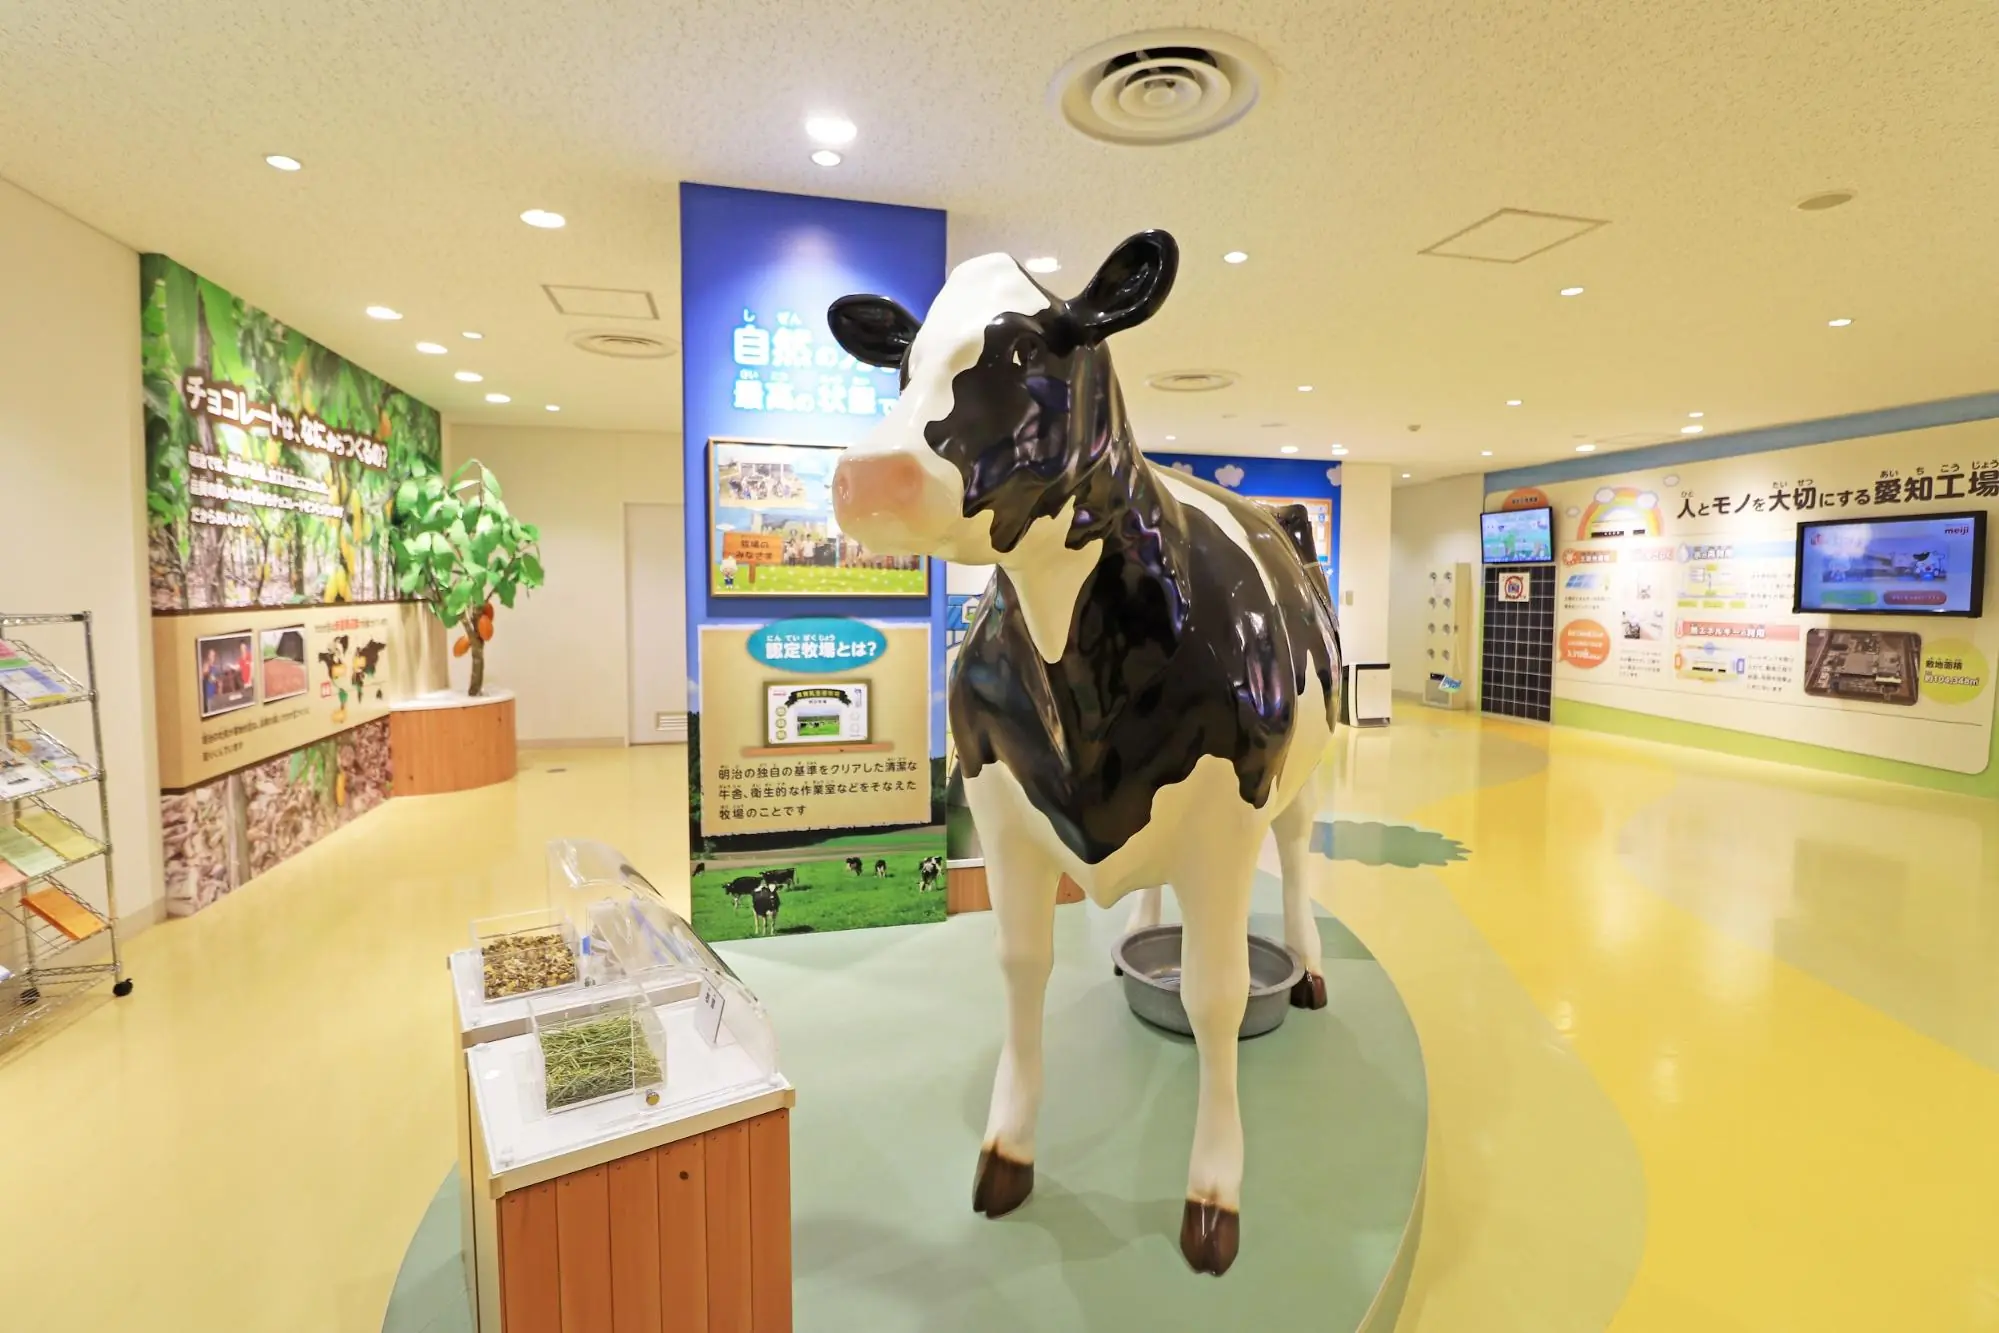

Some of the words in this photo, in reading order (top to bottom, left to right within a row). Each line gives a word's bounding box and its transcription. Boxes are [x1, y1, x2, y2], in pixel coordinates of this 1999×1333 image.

[1880, 470, 1898, 478] あい
[1916, 467, 1925, 475] ち
[1941, 463, 1960, 472] こう
[1972, 460, 1999, 470] じょう
[1677, 470, 1999, 519] 人とモノを大切にする愛知工場
[1944, 526, 1969, 535] meiji
[766, 641, 877, 659] 認定牧場とは?
[719, 761, 917, 780] 明治の独自の基準をクリアした清潔な
[719, 781, 917, 800] 牛舎、衛生的な作業室などをそなえた
[719, 805, 807, 820] 牧場のことです
